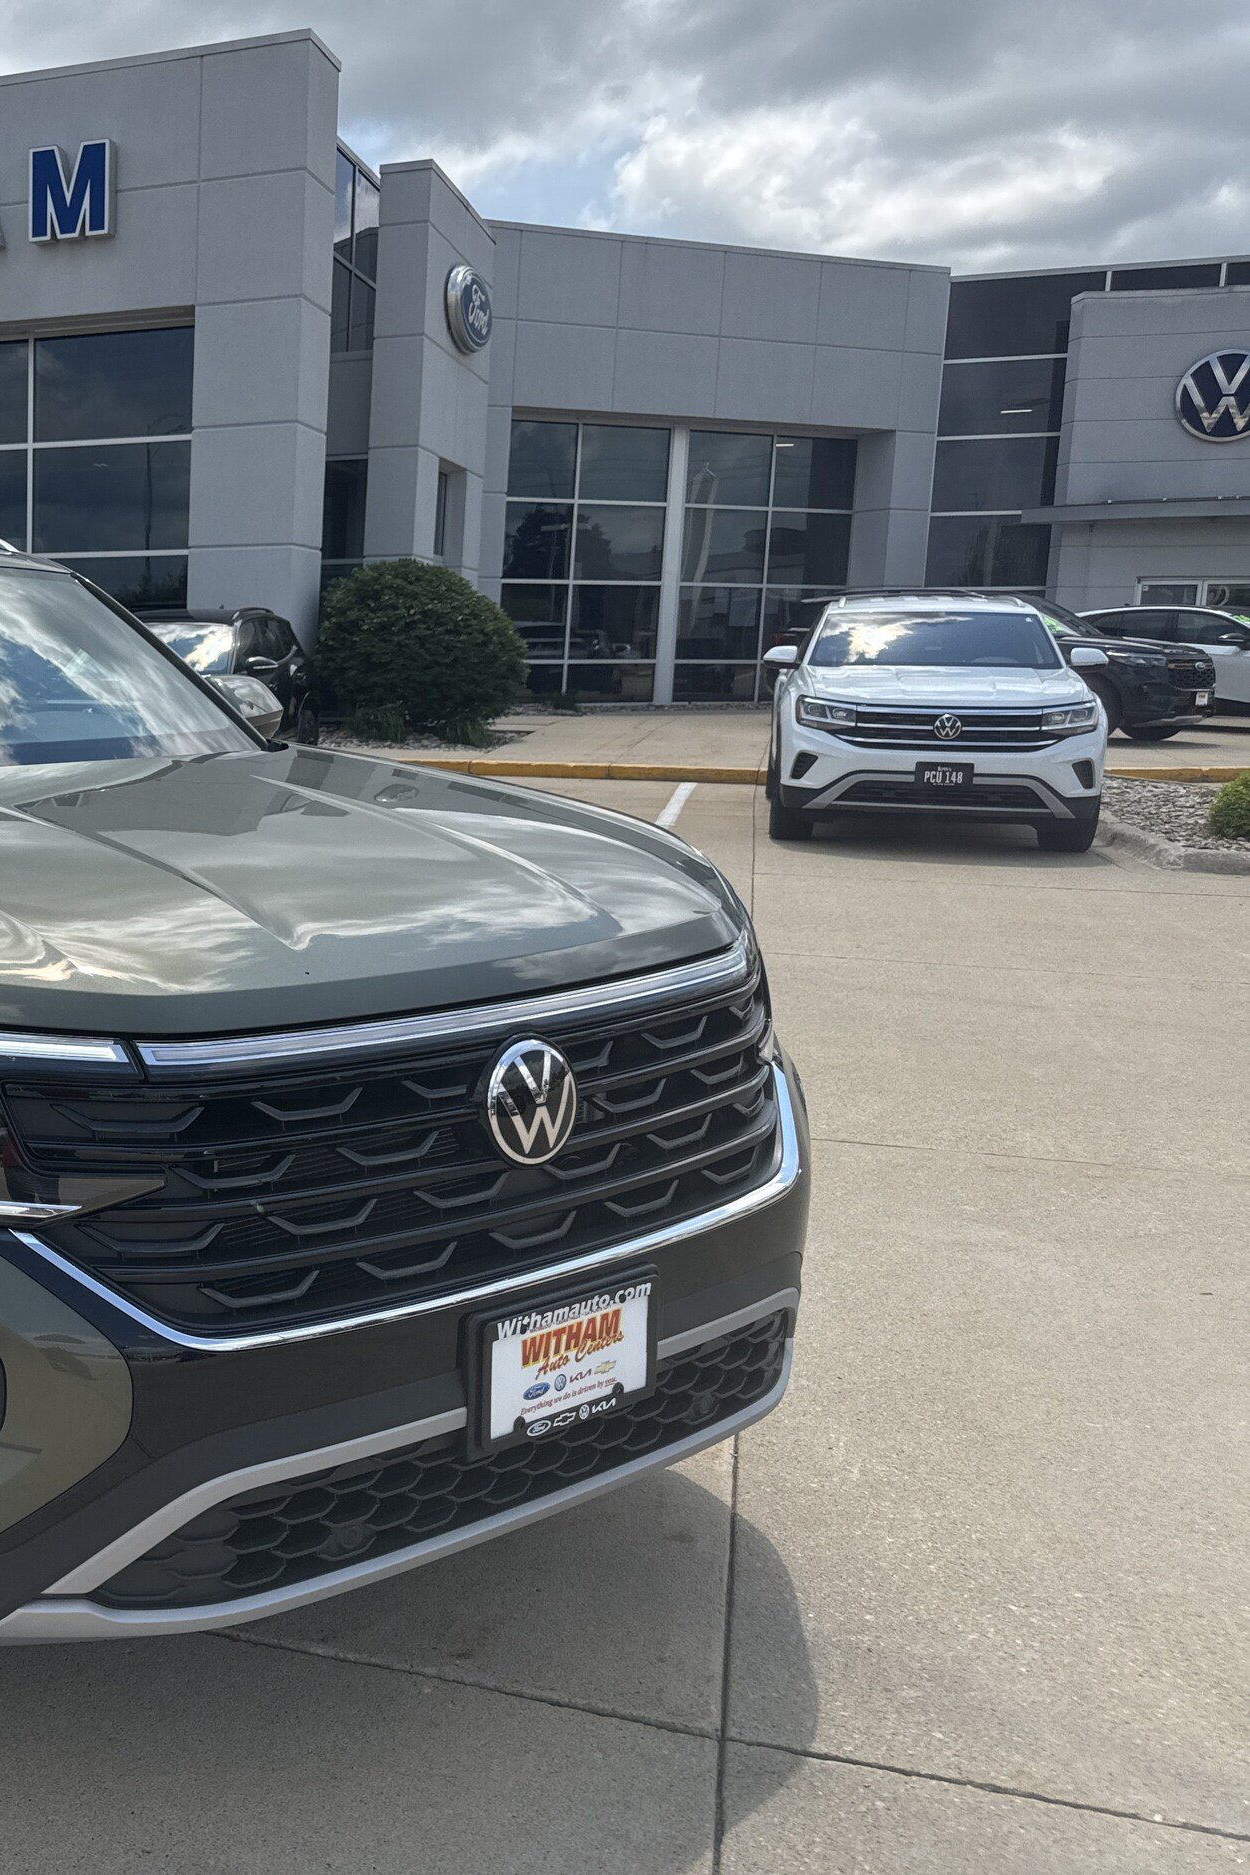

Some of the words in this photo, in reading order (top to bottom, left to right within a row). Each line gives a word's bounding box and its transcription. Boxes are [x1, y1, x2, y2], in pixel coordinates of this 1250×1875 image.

[468, 284, 490, 336] Ford
[924, 771, 943, 783] PCU
[945, 771, 963, 784] 148
[497, 1282, 652, 1339] Withamauto.com
[521, 1307, 623, 1369] WITHAM
[535, 1353, 570, 1380] Auto
[575, 1329, 624, 1363] Centers
[520, 1399, 553, 1415] Everything
[554, 1396, 562, 1404] we
[563, 1392, 571, 1400] do
[577, 1384, 596, 1395] driven
[597, 1380, 604, 1389] by
